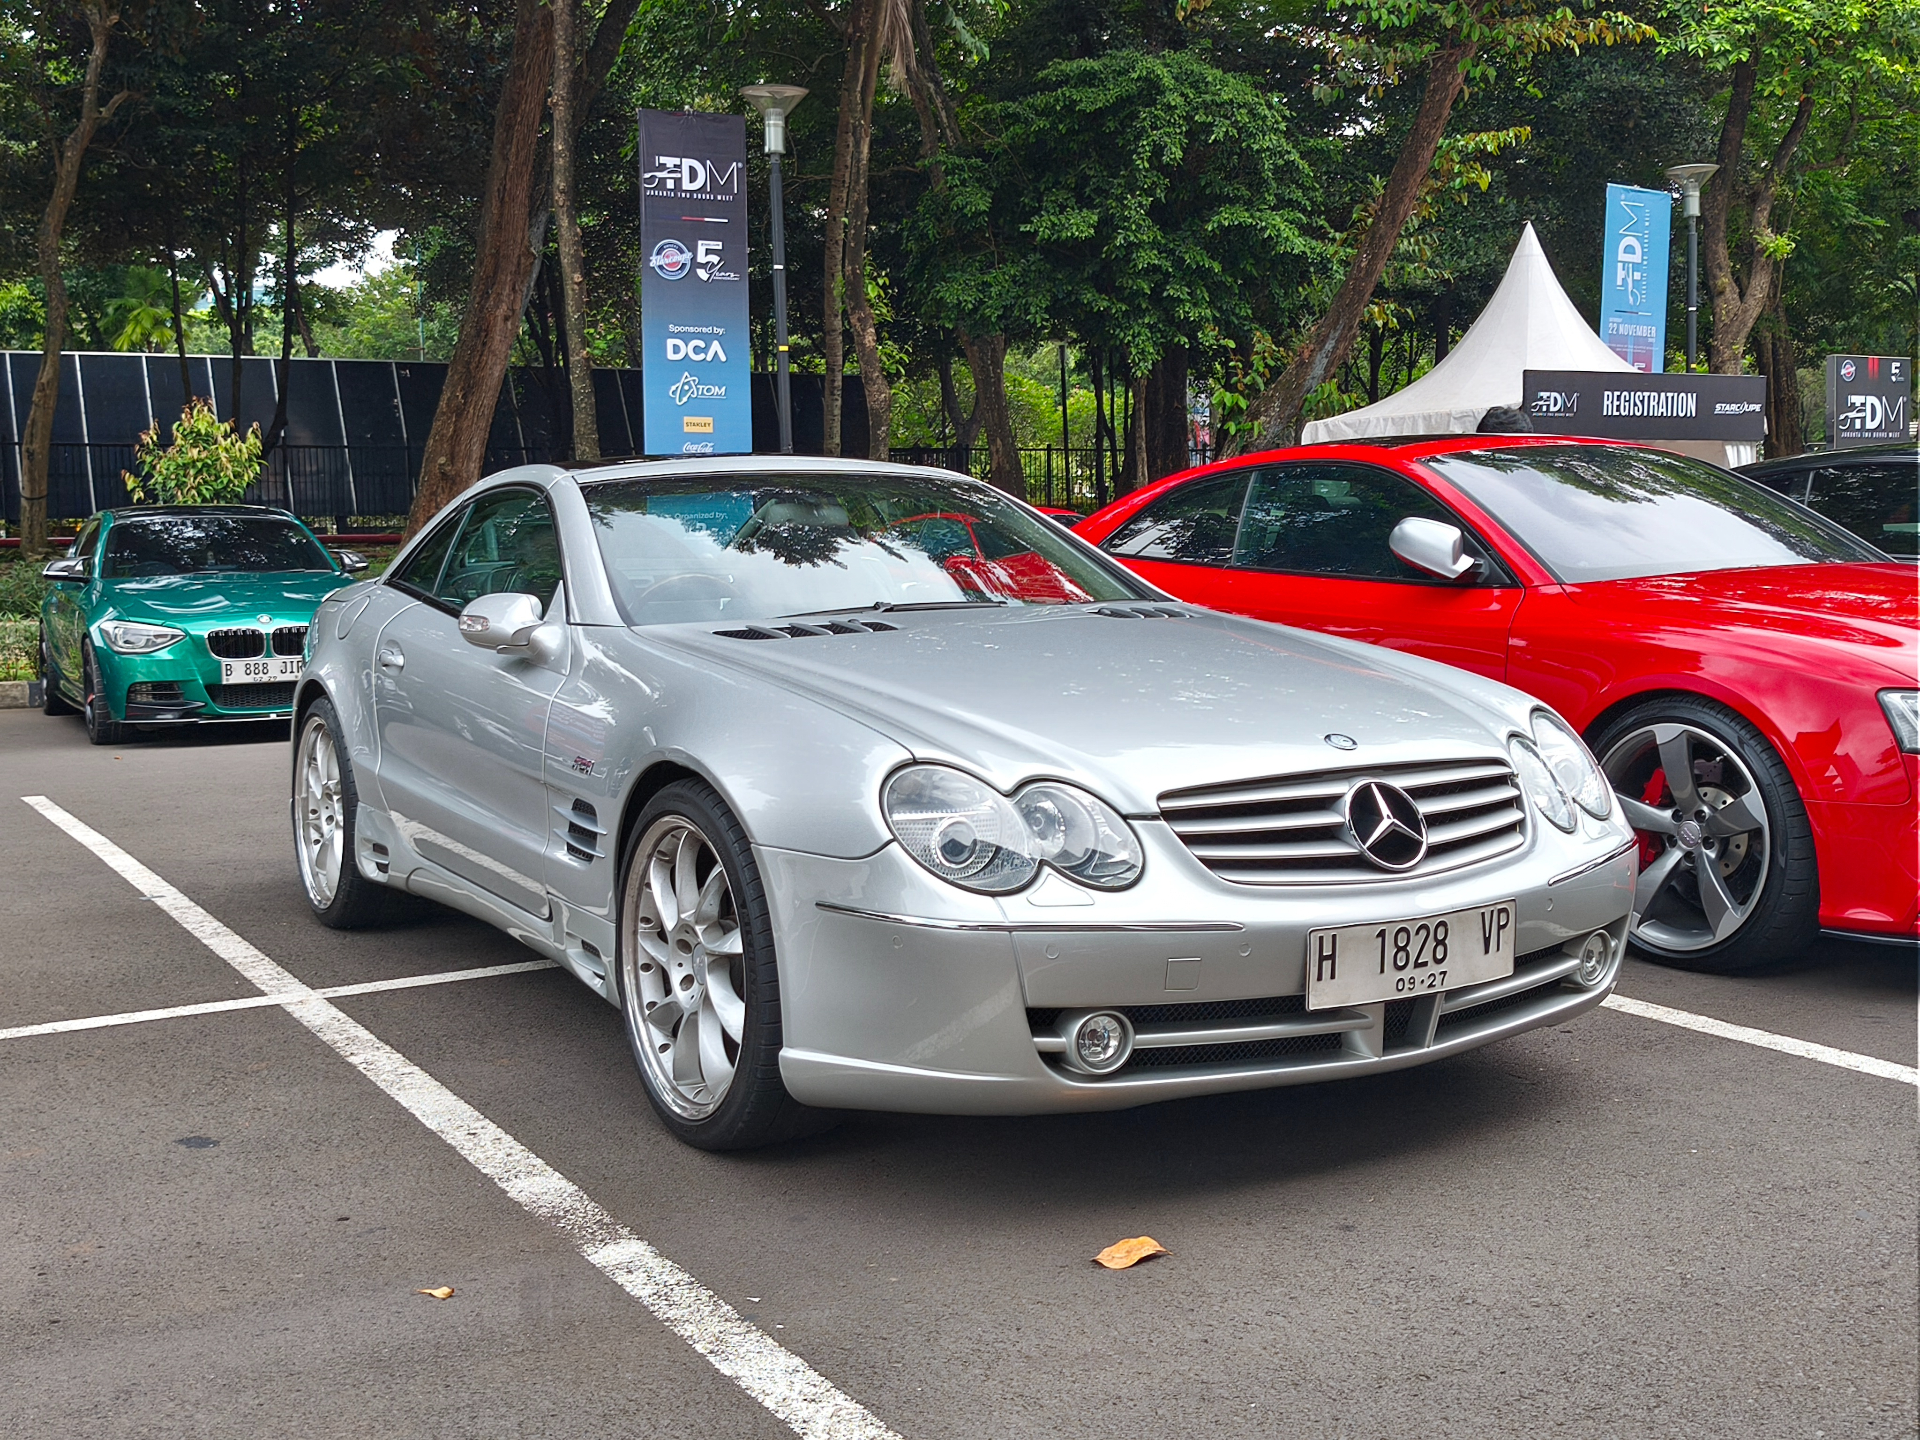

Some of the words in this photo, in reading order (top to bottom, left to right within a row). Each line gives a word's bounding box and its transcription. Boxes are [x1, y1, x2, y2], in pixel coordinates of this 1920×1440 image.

[696, 240, 723, 281] 5
[668, 323, 712, 334] Sponsored
[713, 326, 726, 337] by:
[1608, 322, 1618, 335] 22
[1619, 323, 1656, 337] NOVEMBER
[666, 338, 727, 362] DCA
[1602, 391, 1697, 418] REGISTRATION
[674, 512, 714, 522] Organized
[224, 663, 233, 677] B
[244, 662, 269, 676] 888
[1316, 933, 1338, 982] H
[1375, 919, 1449, 975] 1828
[1480, 907, 1510, 955] VP
